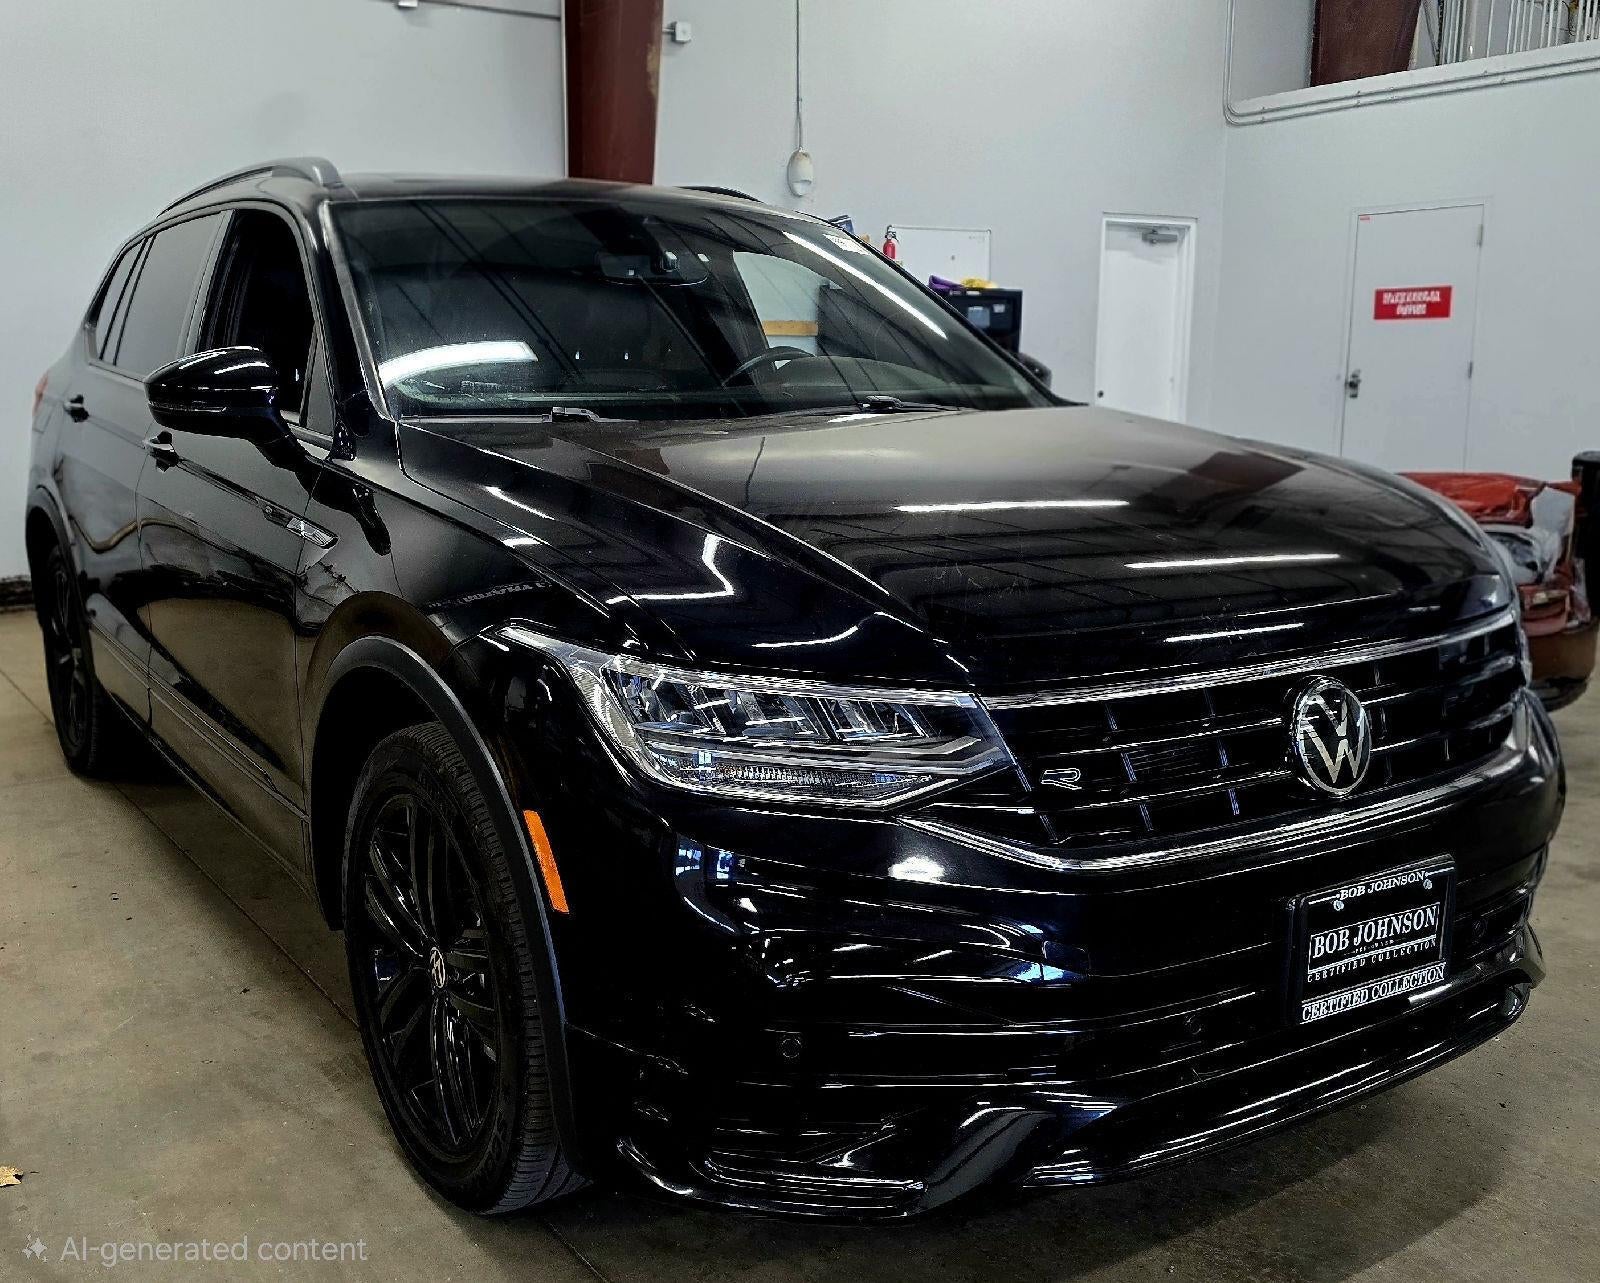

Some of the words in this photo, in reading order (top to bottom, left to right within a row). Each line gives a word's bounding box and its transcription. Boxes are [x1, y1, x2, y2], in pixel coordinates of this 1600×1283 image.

[1340, 885, 1366, 900] BOB
[1367, 870, 1426, 894] JOHNSON
[1312, 928, 1350, 959] BOB
[1353, 905, 1437, 946] JOHNSON
[1307, 958, 1366, 983] CERTIFIED
[1371, 938, 1437, 964] COLLECTION
[1302, 989, 1369, 1021] CERTIFIED
[1371, 963, 1446, 1000] COLLECTION
